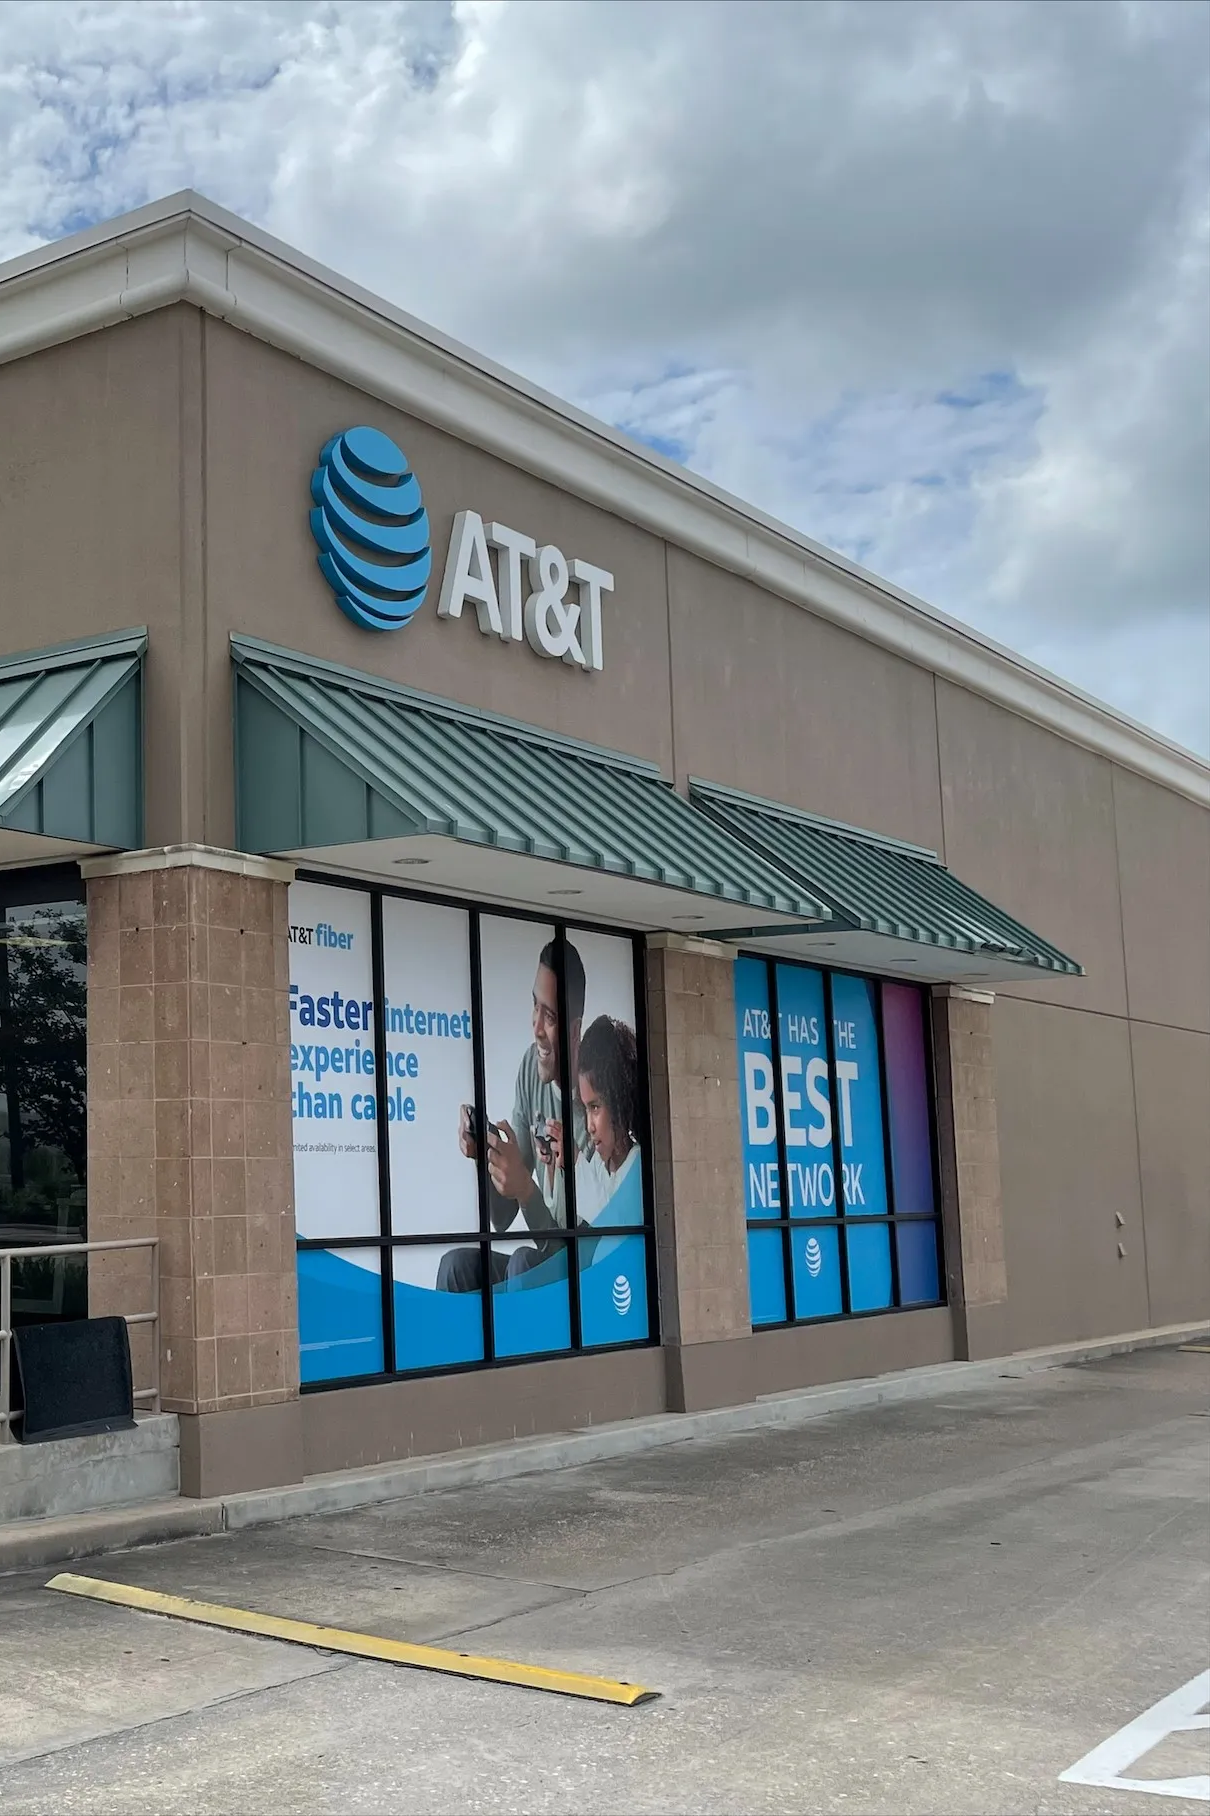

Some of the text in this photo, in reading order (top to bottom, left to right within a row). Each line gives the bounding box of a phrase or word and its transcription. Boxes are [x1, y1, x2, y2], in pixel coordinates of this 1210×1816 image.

[437, 508, 615, 673] AT&T
[315, 922, 354, 950] fiber
[384, 997, 472, 1040] internet
[743, 1008, 857, 1050] AT& HAS HE
[743, 1051, 859, 1149] BEST
[748, 1162, 867, 1209] NETWORK
